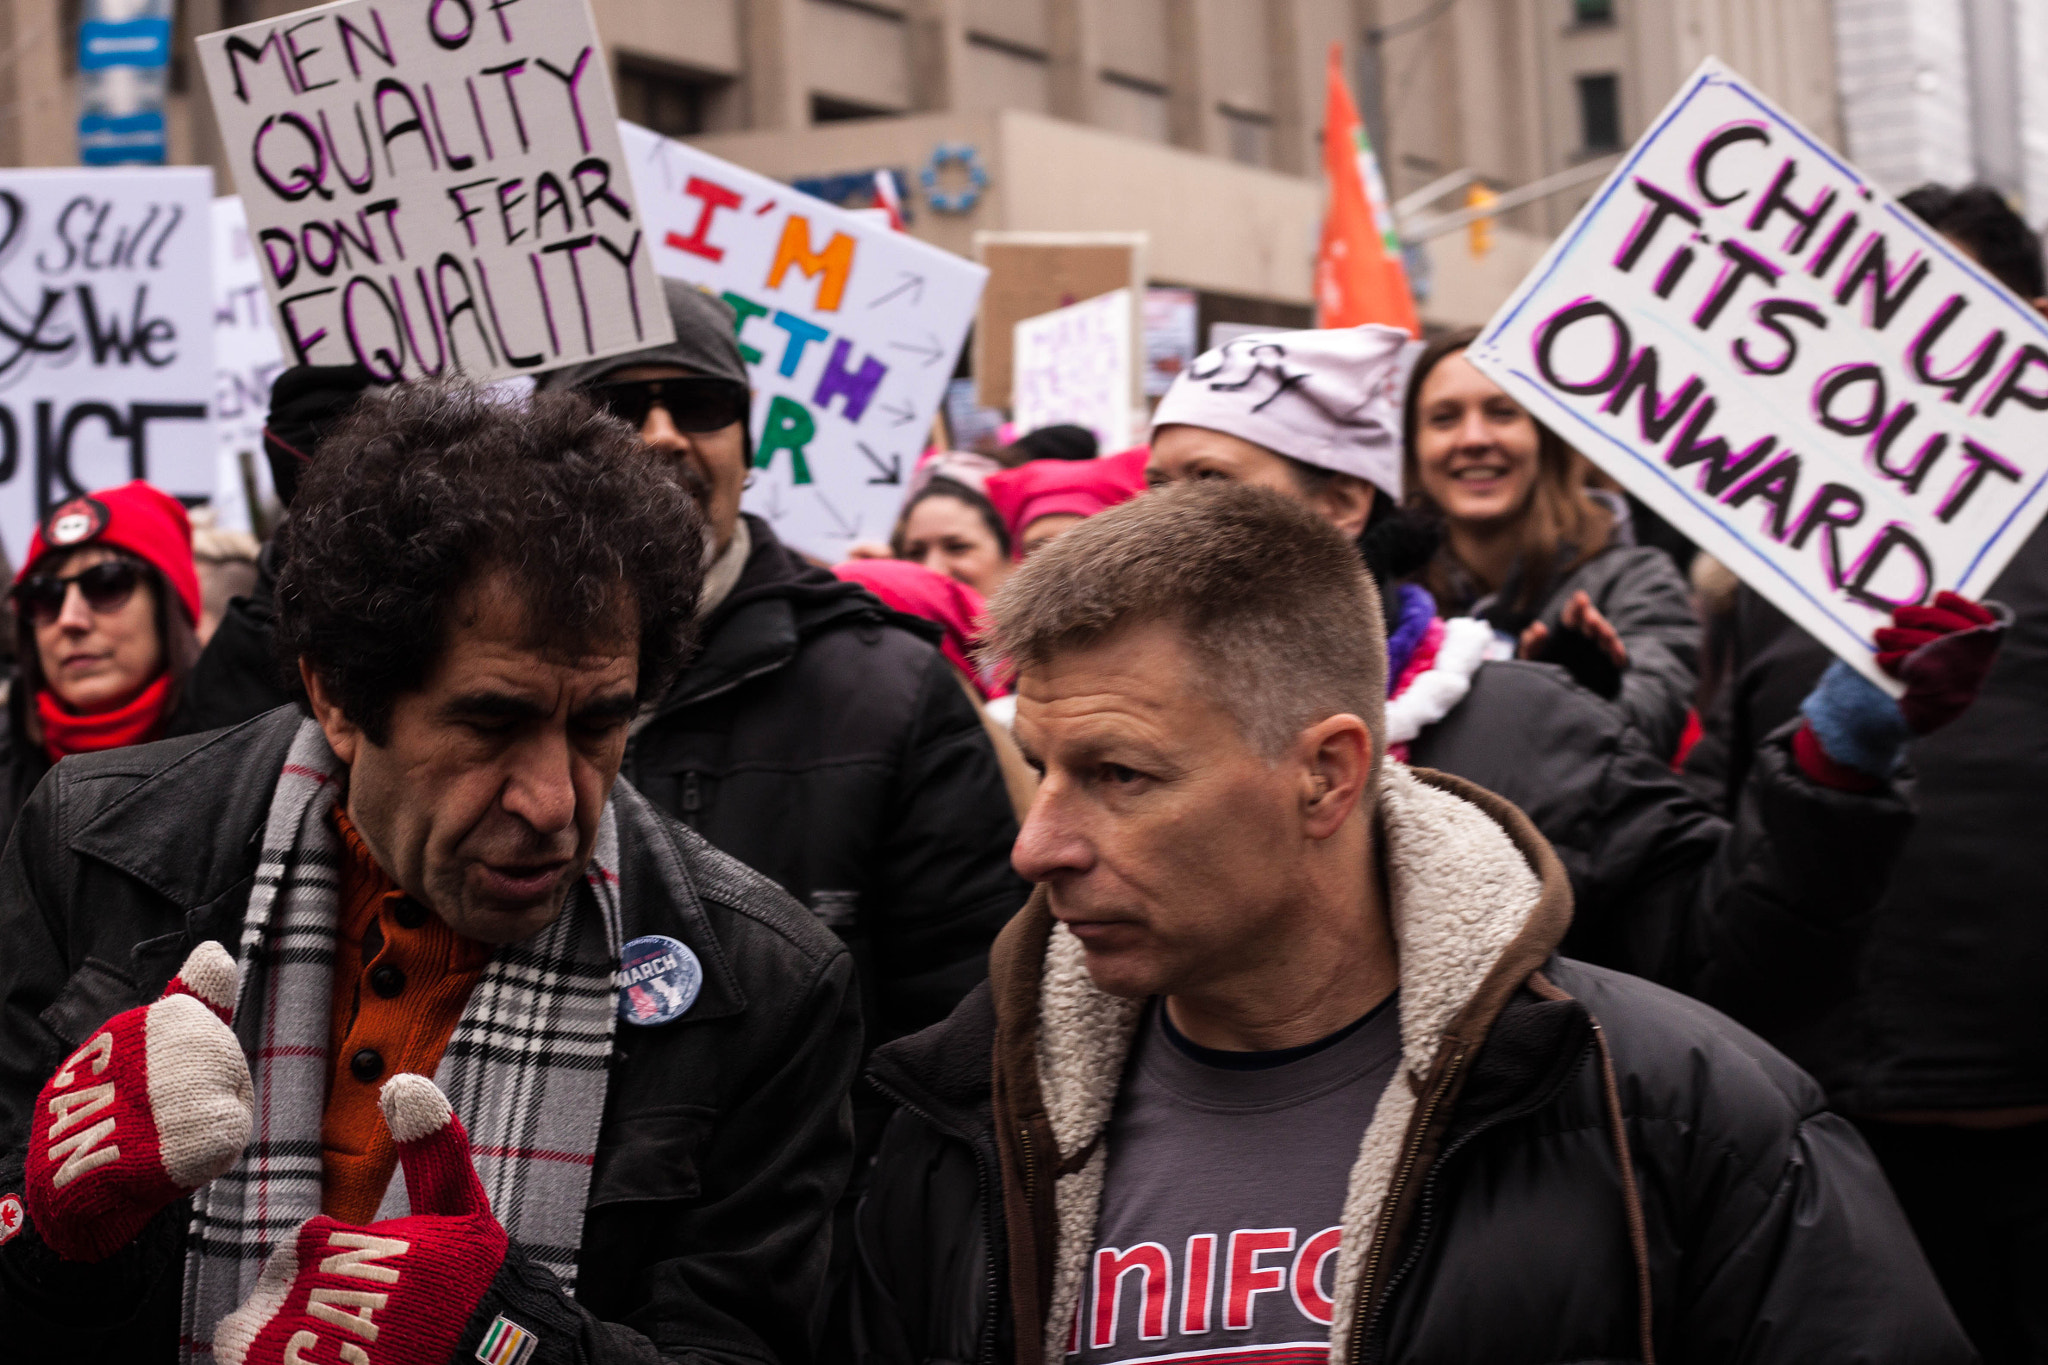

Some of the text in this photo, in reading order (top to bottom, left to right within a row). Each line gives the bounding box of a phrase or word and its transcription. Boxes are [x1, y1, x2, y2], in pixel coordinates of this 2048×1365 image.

[224, 8, 397, 104] MEN
[252, 46, 594, 201] QUALITY
[35, 194, 184, 275] Still
[259, 158, 633, 289] DONT FEAR
[664, 175, 858, 313] I'M
[74, 283, 180, 367] We
[279, 229, 643, 382] EQUALITY
[715, 289, 888, 424] ITH
[1903, 294, 2048, 419] UP
[1531, 294, 1934, 614] ONWARD
[1811, 362, 2024, 523] OUT
[48, 1031, 121, 1190] CAN
[283, 1231, 411, 1365] CAN
